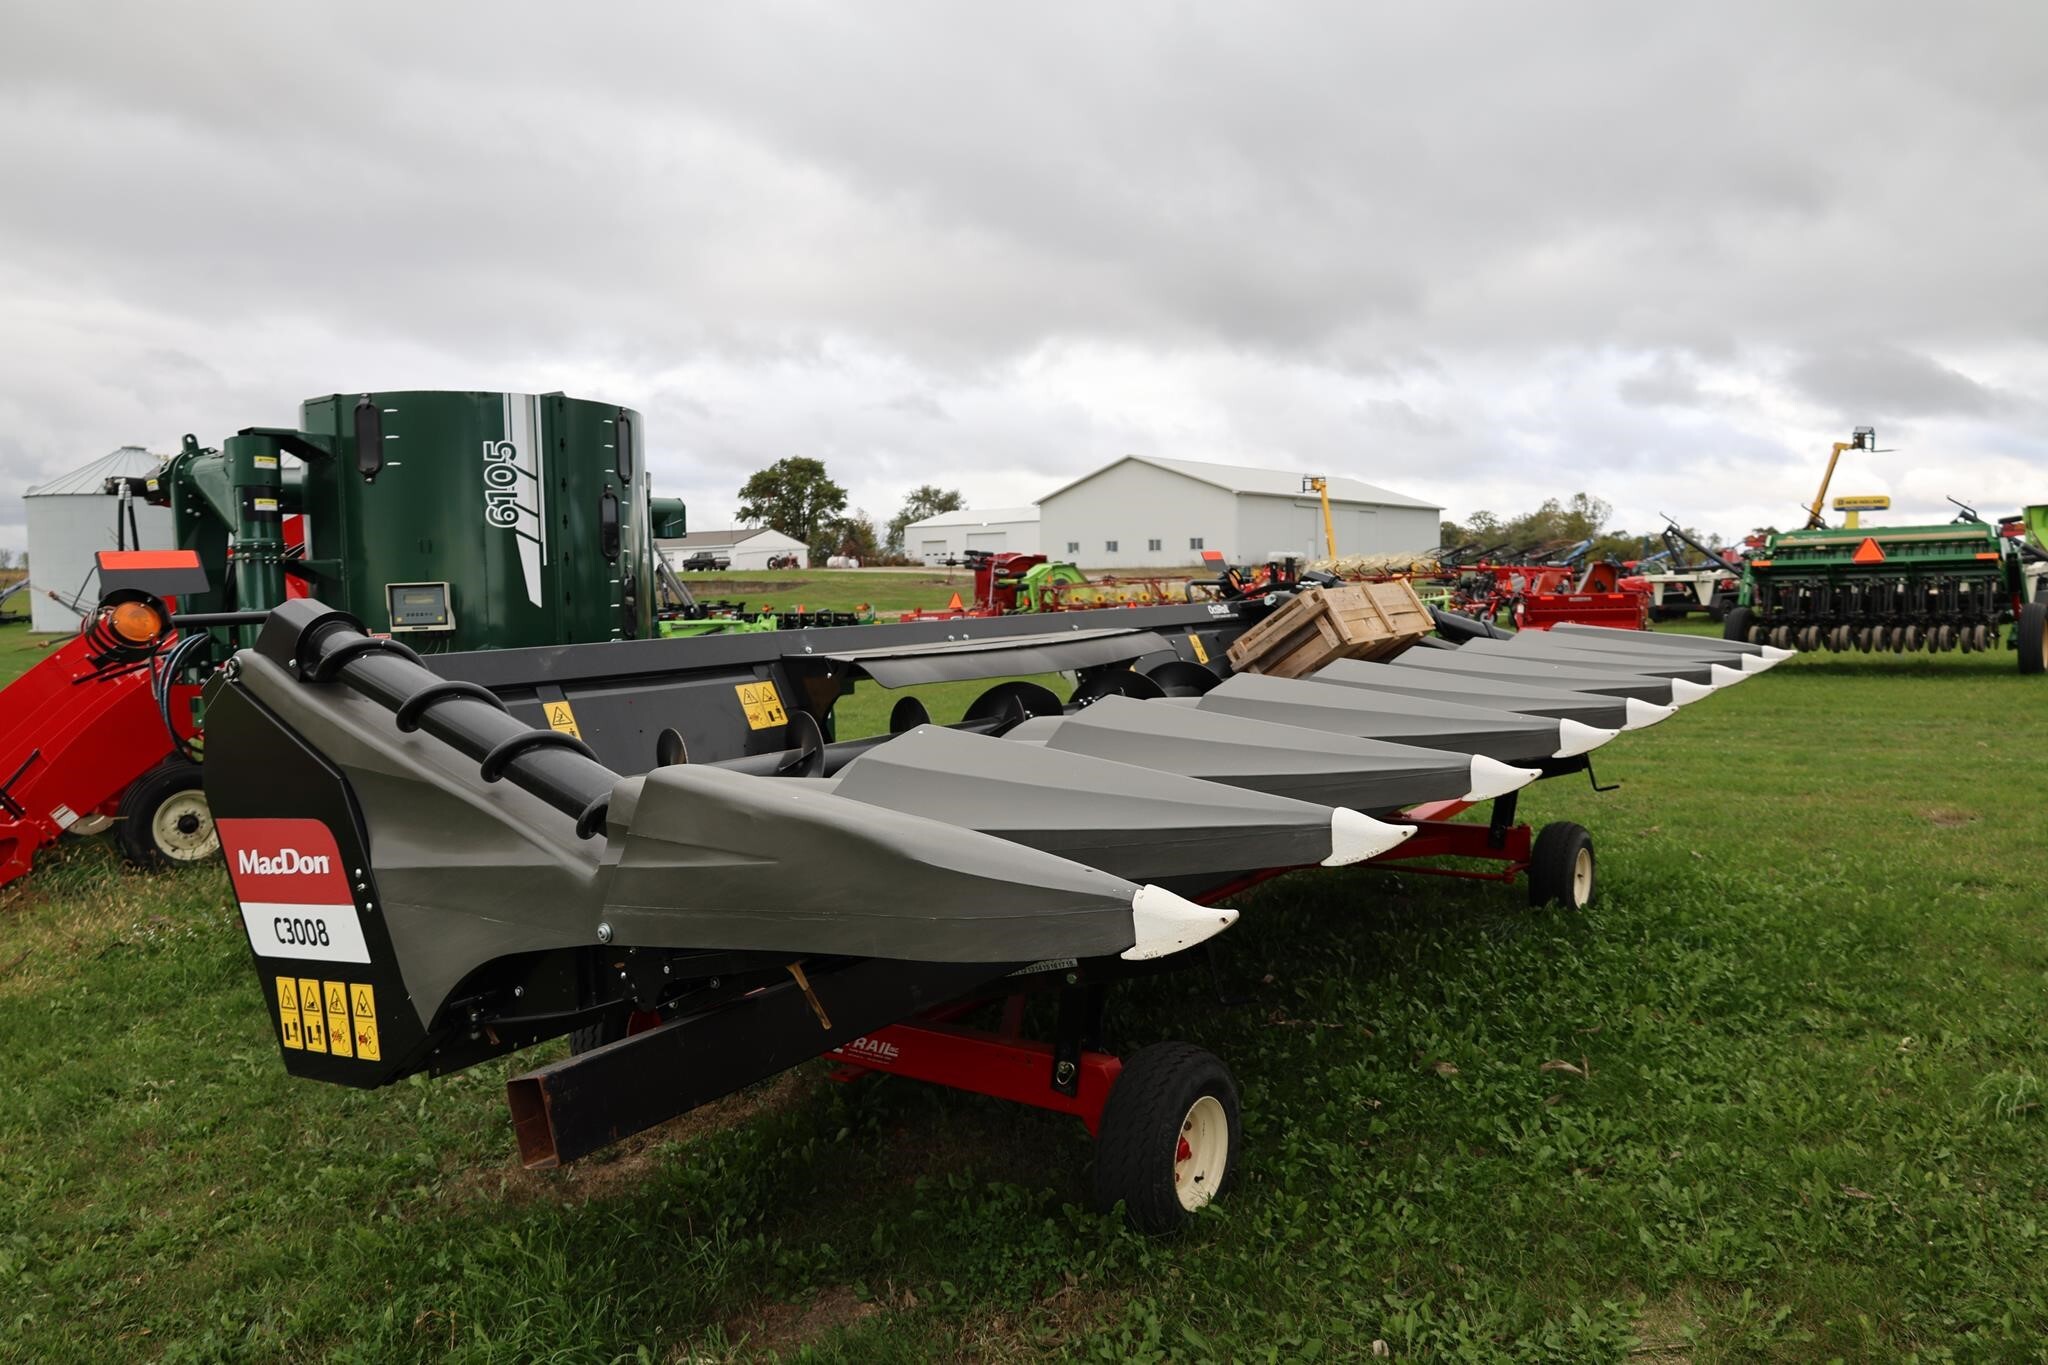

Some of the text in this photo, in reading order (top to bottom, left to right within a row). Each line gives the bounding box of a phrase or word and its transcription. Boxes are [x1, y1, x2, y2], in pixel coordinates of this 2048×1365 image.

[483, 440, 519, 528] 6105
[238, 848, 330, 875] MacDon
[274, 917, 330, 947] C3008
